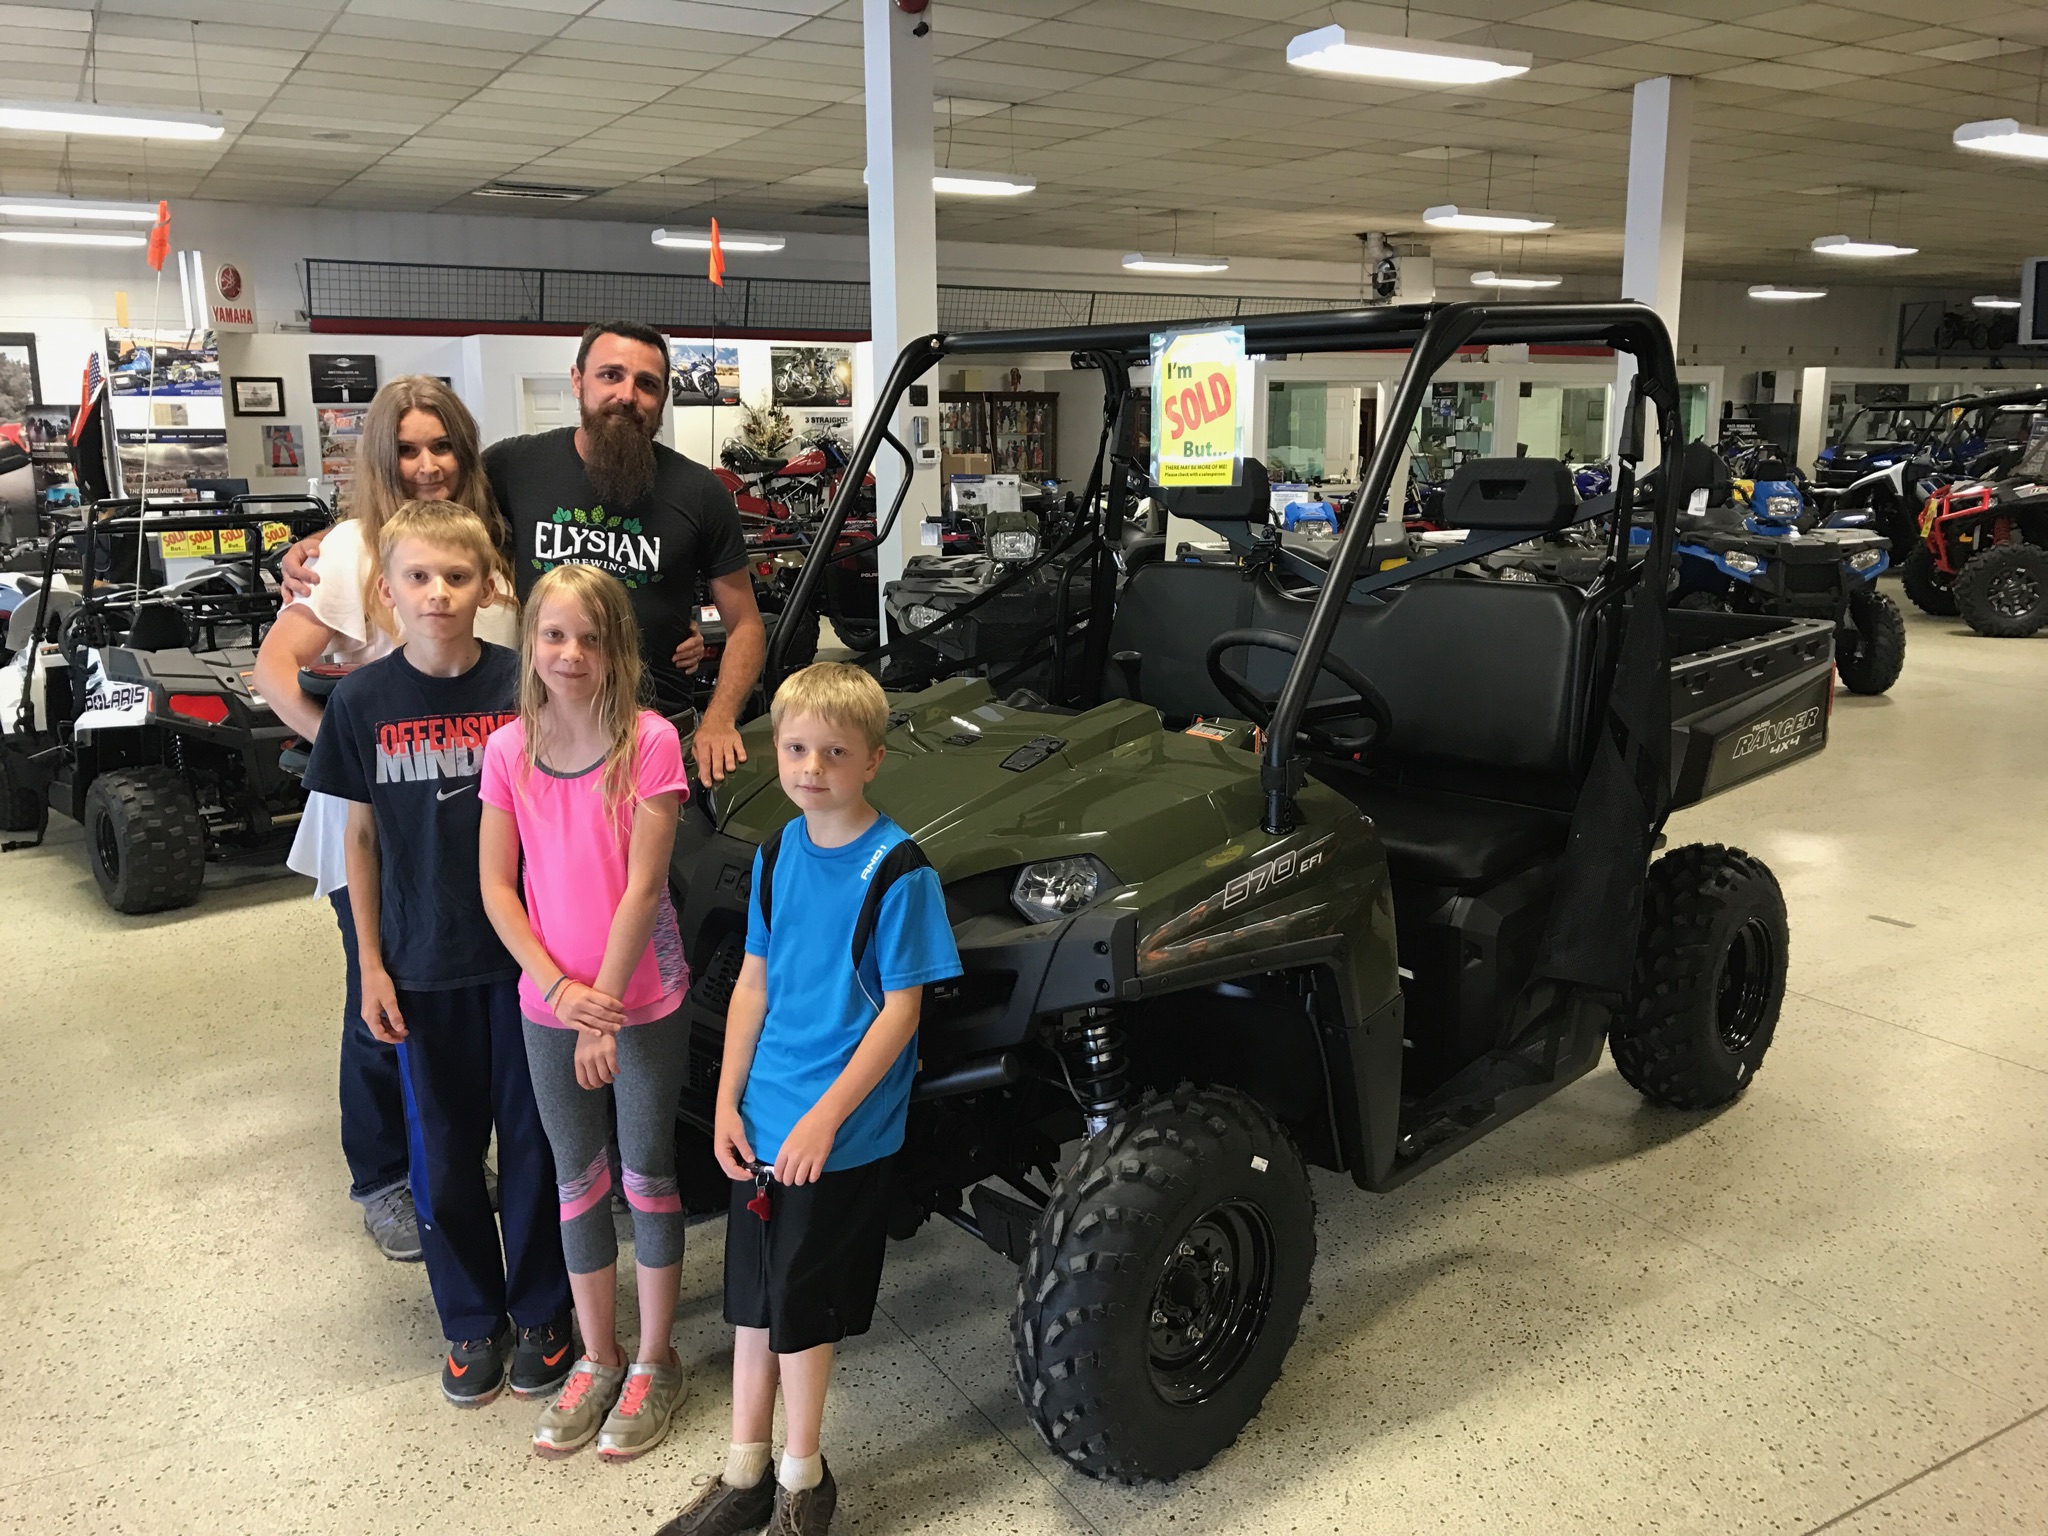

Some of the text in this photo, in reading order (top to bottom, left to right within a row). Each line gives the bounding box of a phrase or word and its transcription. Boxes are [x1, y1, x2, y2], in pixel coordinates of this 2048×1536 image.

[212, 306, 253, 324] YAMAHA
[1167, 362, 1192, 380] I'm
[1165, 372, 1232, 440] SOLD
[805, 416, 810, 424] 3
[163, 531, 187, 547] SOLD
[189, 530, 213, 546] SOLD
[220, 529, 244, 544] SOLD
[265, 526, 287, 543] SOLD
[534, 521, 661, 572] ELYSIAN
[562, 558, 628, 574] BREWING
[85, 686, 146, 712] POLARIS
[380, 715, 520, 756] OFFENSIV
[1732, 706, 1819, 760] RANGER
[1299, 851, 1323, 874] EFI
[1222, 850, 1297, 911] 570
